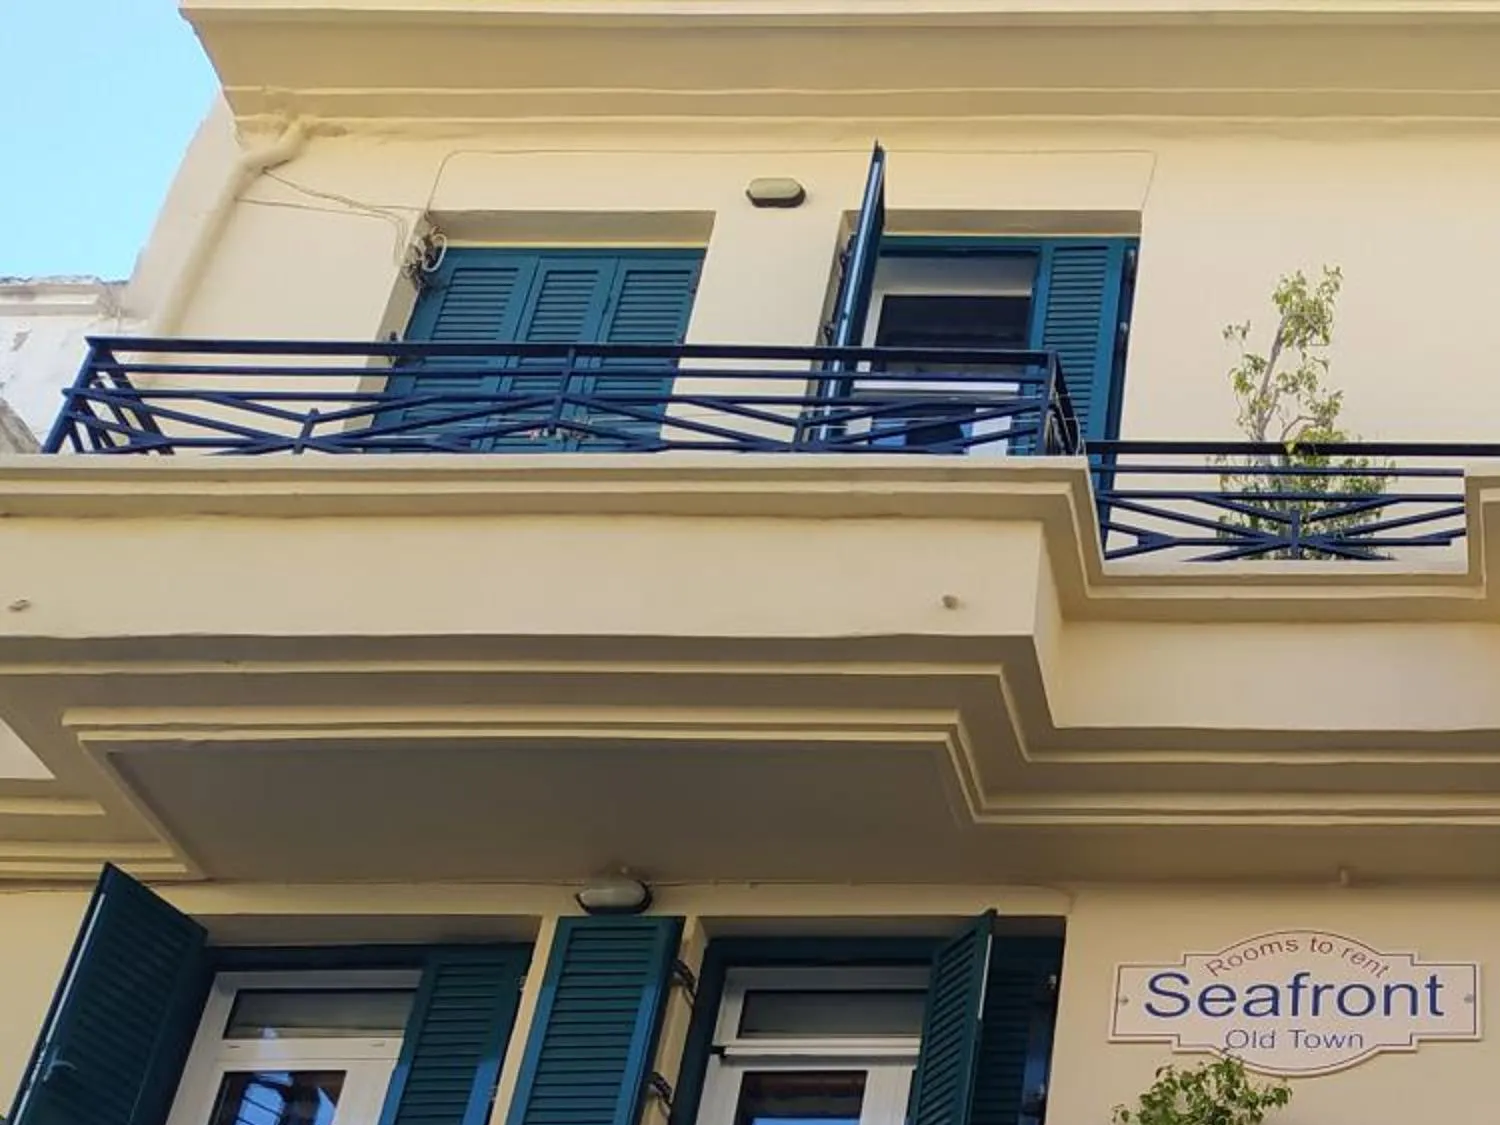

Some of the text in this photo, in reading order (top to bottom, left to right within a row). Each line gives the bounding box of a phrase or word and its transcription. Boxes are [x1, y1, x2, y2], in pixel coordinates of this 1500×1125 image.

[1206, 936, 1391, 978] Rooms to rent
[1144, 972, 1445, 1017] Seafront
[1224, 1028, 1364, 1051] Old Town
